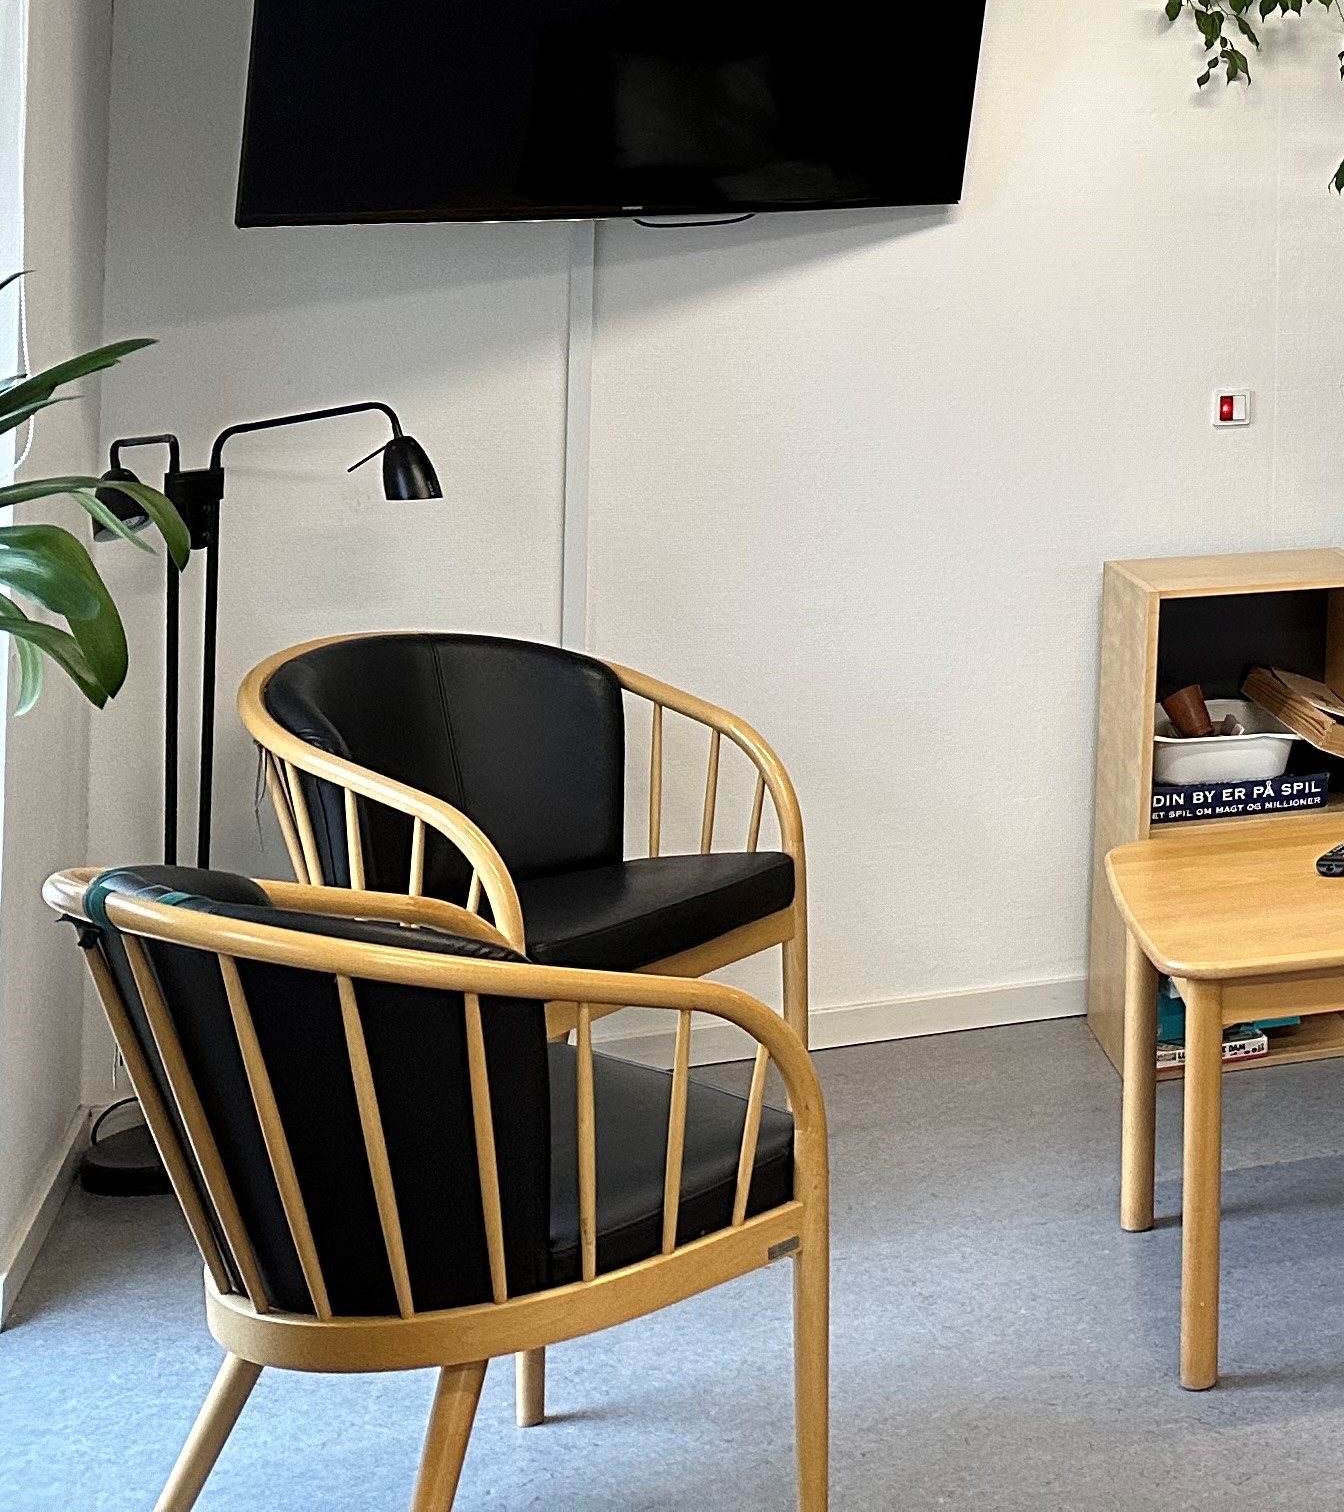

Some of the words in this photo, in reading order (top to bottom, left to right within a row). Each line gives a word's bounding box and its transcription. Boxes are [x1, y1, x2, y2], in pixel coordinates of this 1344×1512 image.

[1152, 793, 1185, 808] DIN
[1192, 790, 1216, 804] BY
[1222, 788, 1246, 801] ER
[1253, 780, 1275, 799] PÅ
[1281, 780, 1322, 796] SPIL
[1152, 811, 1166, 820] ET
[1168, 809, 1193, 819] SPIL
[1196, 808, 1212, 816] OM
[1215, 804, 1245, 814] MAGT
[1247, 802, 1262, 811] OG
[1264, 797, 1321, 810] MILLIONER
